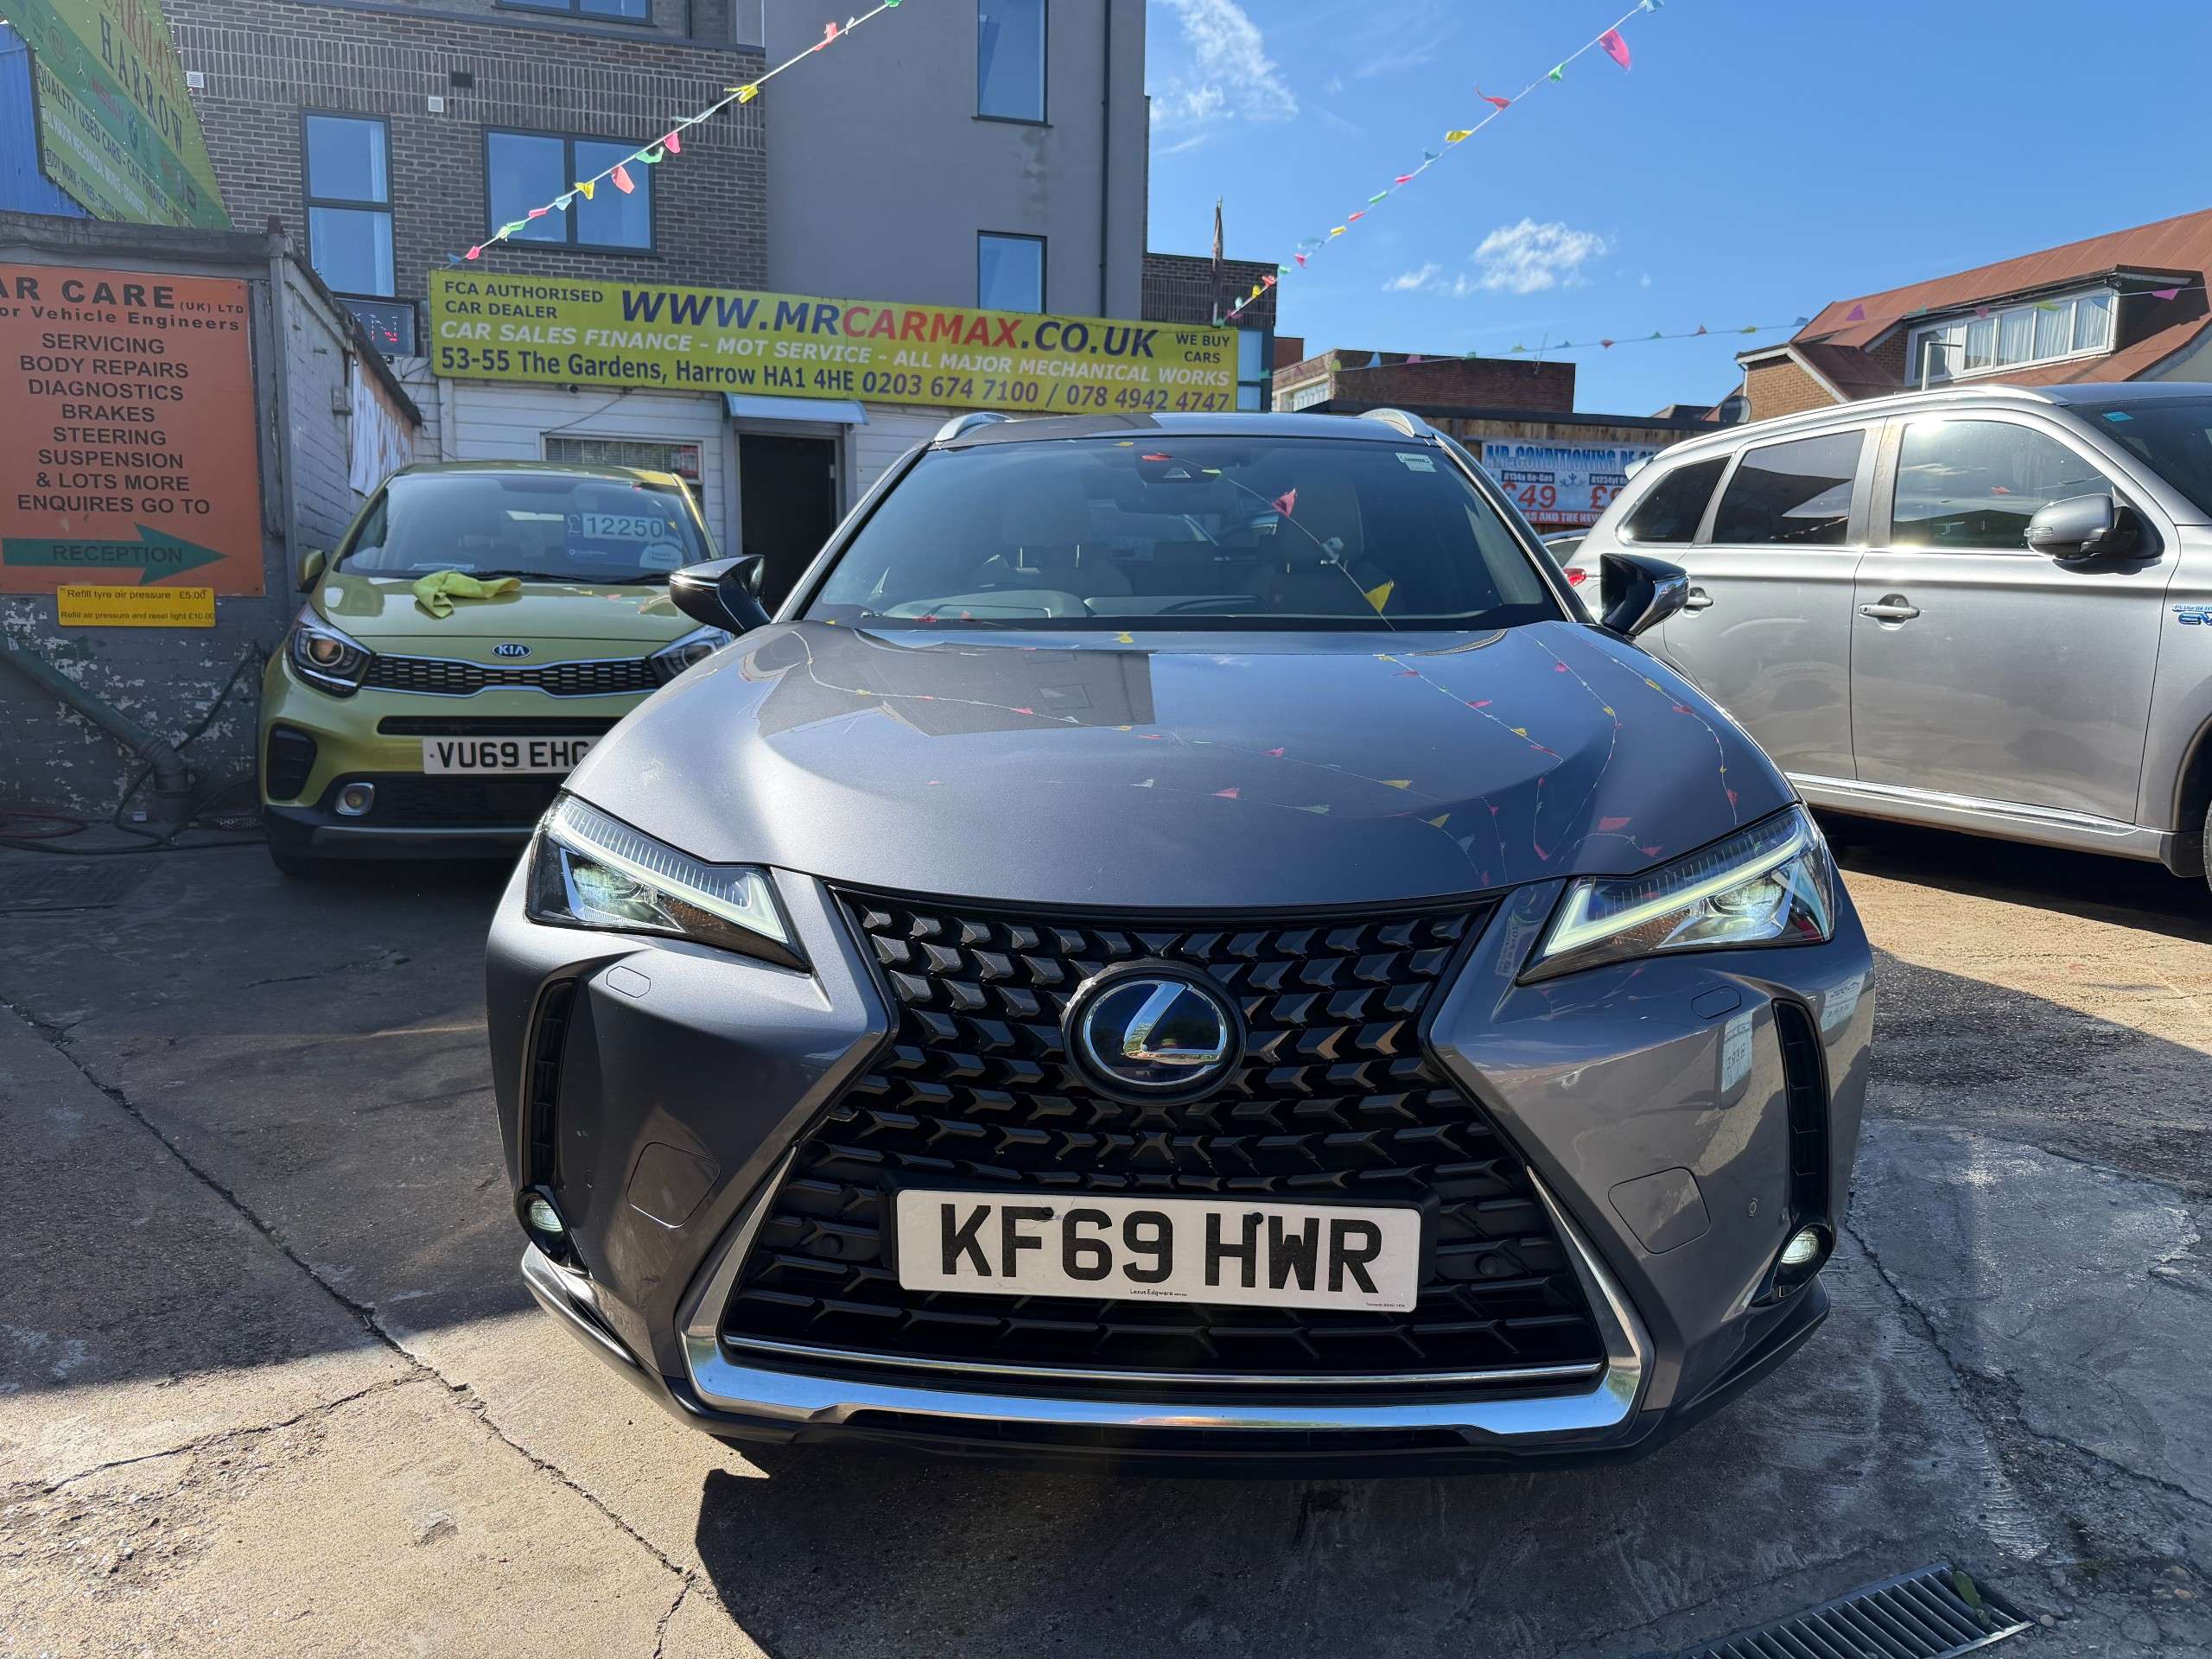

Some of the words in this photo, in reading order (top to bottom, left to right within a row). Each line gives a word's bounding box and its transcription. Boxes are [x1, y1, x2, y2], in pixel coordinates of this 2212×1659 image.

[99, 11, 182, 155] HARROW
[35, 61, 77, 119] QUALITY
[79, 107, 100, 143] USED
[102, 131, 122, 165] CARS
[61, 279, 175, 309] CARE
[445, 281, 479, 296] FCA
[485, 283, 603, 303] AUTHORISED
[31, 306, 118, 322] Vehicle
[127, 312, 240, 330] Engineers
[180, 302, 212, 313] (UK)
[218, 304, 244, 314] LTD
[445, 300, 482, 315] CAR
[488, 302, 558, 319] DEALER
[622, 289, 1159, 358] WWW.MRCARMAX.CO.UK
[41, 333, 164, 354] SERVICING
[1175, 333, 1198, 346] WE
[1202, 334, 1230, 347] BUY
[441, 321, 492, 340] CAR
[499, 324, 577, 346] SALES
[584, 329, 693, 352] FINANCE
[716, 337, 769, 357] MOT
[774, 341, 872, 364] SERVICE
[893, 349, 932, 369] ALL
[939, 353, 1013, 373] MAJOR
[1019, 359, 1150, 383] MECHANICAL
[1158, 368, 1230, 387] WORKS
[1184, 351, 1221, 364] CARS
[21, 355, 85, 373] BODY
[92, 359, 189, 378] REPAIRS
[442, 346, 510, 372] 53-55
[518, 350, 560, 374] The
[568, 353, 667, 385] Gardens,
[677, 359, 756, 385] Harrow
[764, 365, 806, 388] HA1
[813, 368, 855, 391] 4HE
[862, 371, 923, 397] 0203
[931, 375, 974, 400] 674
[982, 379, 1039, 404] 7100
[1067, 384, 1108, 408] 078
[1114, 387, 1169, 410] 4942
[1175, 391, 1230, 411] 4747
[29, 378, 184, 401] DIAGNOSTICS
[61, 404, 156, 423] BRAKES
[53, 427, 167, 446] STEERING
[38, 448, 184, 469] SUSPENSION
[35, 472, 51, 488] &
[59, 473, 118, 490] LOTS
[124, 474, 190, 492] MORE
[17, 494, 134, 513] ENQUIRES
[141, 497, 175, 514] GO
[181, 498, 210, 515] TO
[53, 544, 183, 563] RECEPTION
[67, 589, 92, 598] Refill
[93, 590, 113, 601] tyre
[114, 589, 127, 599] air
[130, 591, 171, 601] pressure
[498, 645, 525, 656] KIA
[436, 741, 519, 768] VU69
[940, 1203, 1173, 1284] KF69
[1205, 1211, 1383, 1294] HWR
